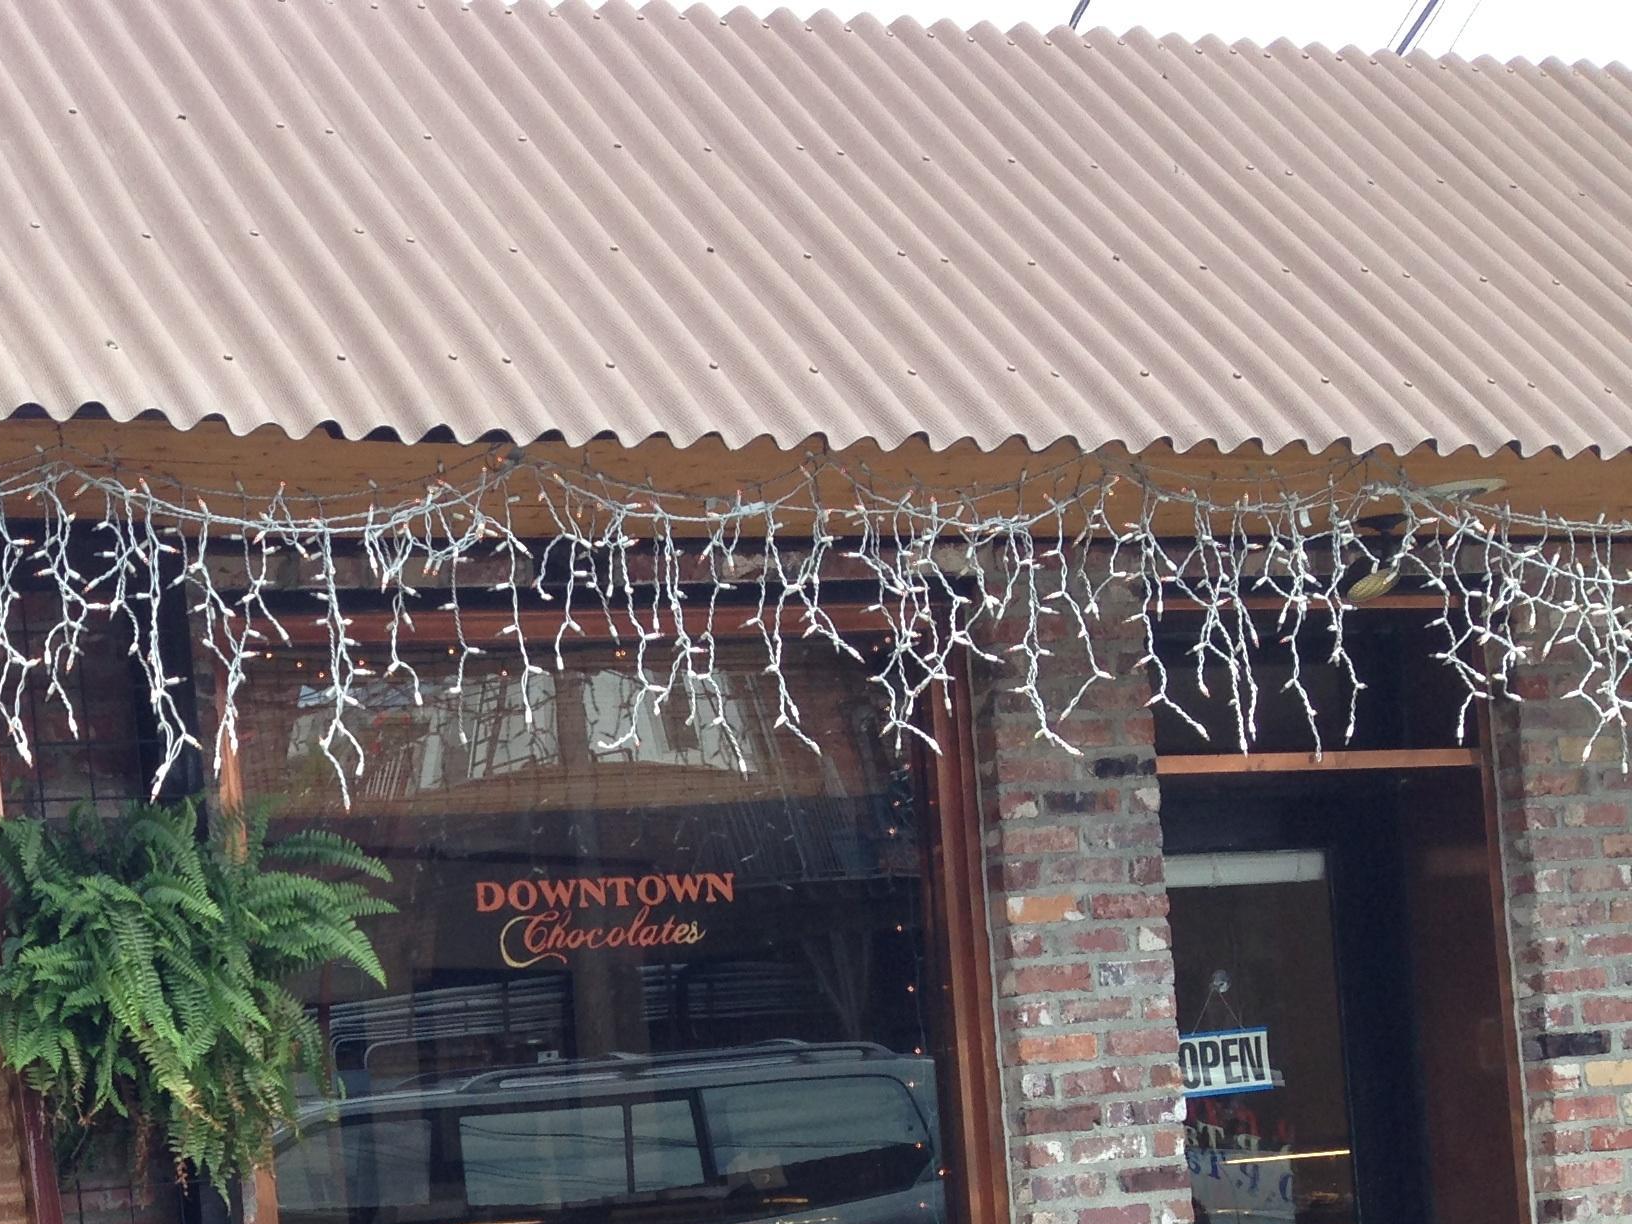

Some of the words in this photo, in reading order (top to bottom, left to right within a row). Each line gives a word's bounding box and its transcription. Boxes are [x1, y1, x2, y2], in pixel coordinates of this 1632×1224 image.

[475, 872, 735, 912] DOWNTOWN
[500, 905, 706, 968] Chocolates
[1179, 1036, 1266, 1089] OPEN
